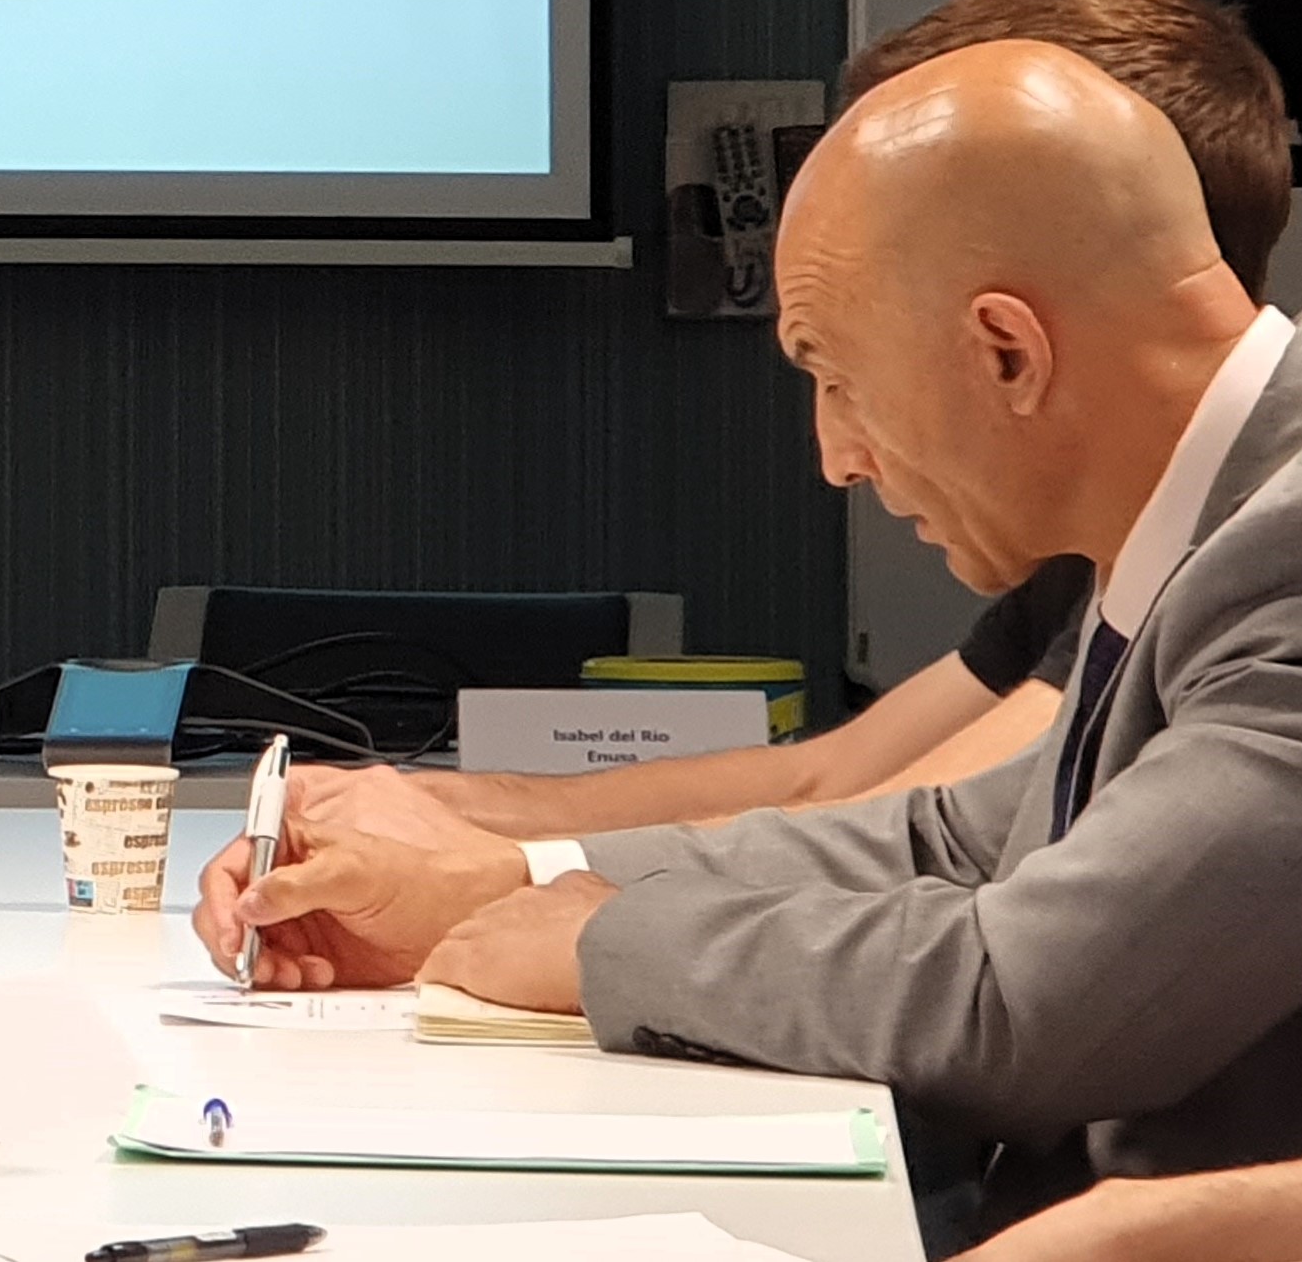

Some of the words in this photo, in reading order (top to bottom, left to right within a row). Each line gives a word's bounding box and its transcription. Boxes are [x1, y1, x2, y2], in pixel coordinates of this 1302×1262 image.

[553, 729, 604, 743] Isabel
[609, 729, 635, 743] del
[587, 750, 638, 763] Enusa
